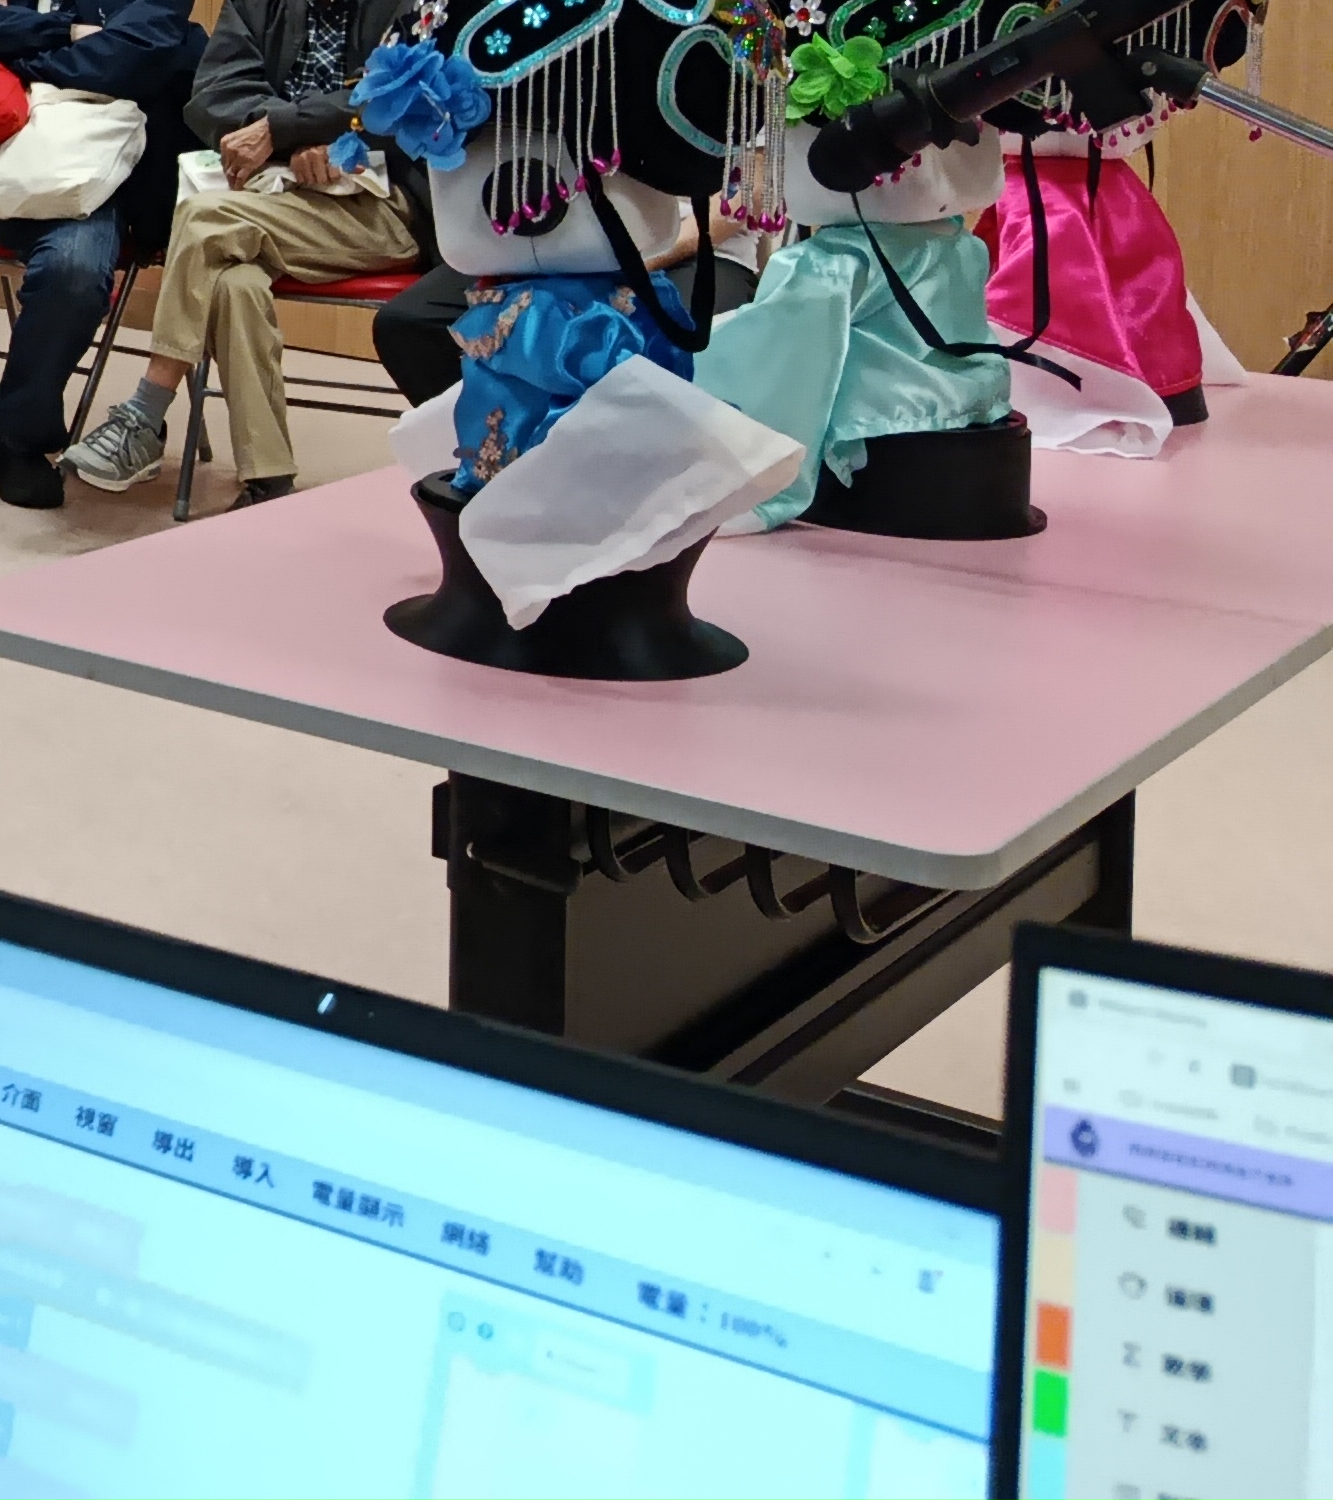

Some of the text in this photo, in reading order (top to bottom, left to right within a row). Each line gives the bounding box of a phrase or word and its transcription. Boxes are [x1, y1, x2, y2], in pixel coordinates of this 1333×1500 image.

[1, 1083, 43, 1113] 介面
[74, 1106, 118, 1137] 視窗
[152, 1129, 196, 1163] 導出
[232, 1155, 275, 1189] 導入
[312, 1179, 406, 1228] 電量顯示
[533, 1247, 585, 1287] 幫助
